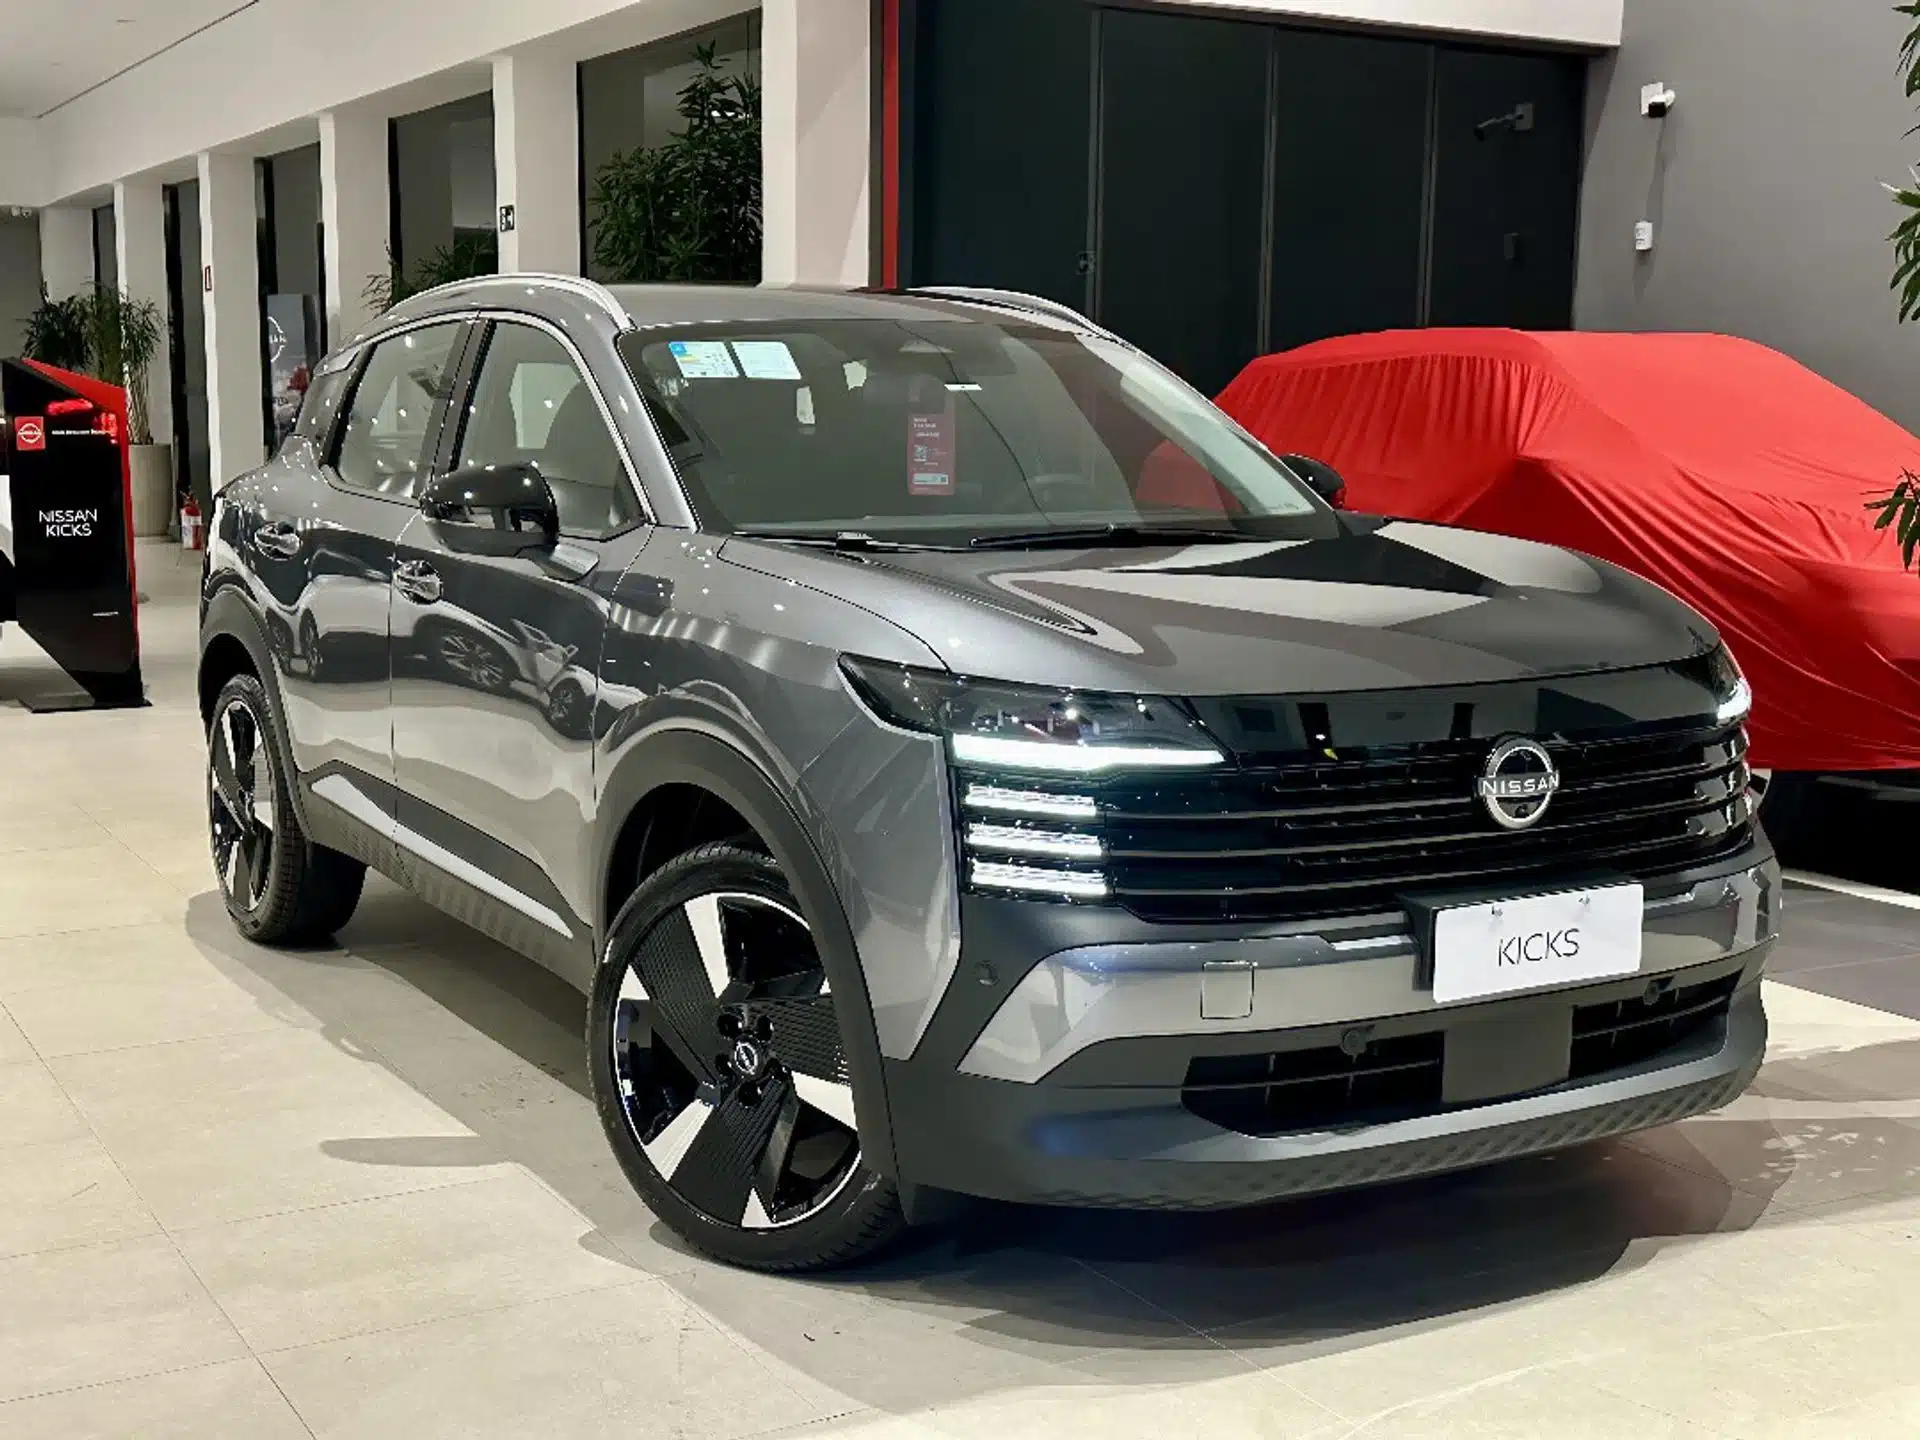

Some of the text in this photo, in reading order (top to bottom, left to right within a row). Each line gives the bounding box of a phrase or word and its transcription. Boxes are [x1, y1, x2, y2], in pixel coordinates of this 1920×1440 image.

[39, 508, 97, 522] NISSAN
[46, 523, 92, 537] KICKS
[1482, 772, 1559, 795] NISSAN
[1498, 928, 1579, 966] KICKS
